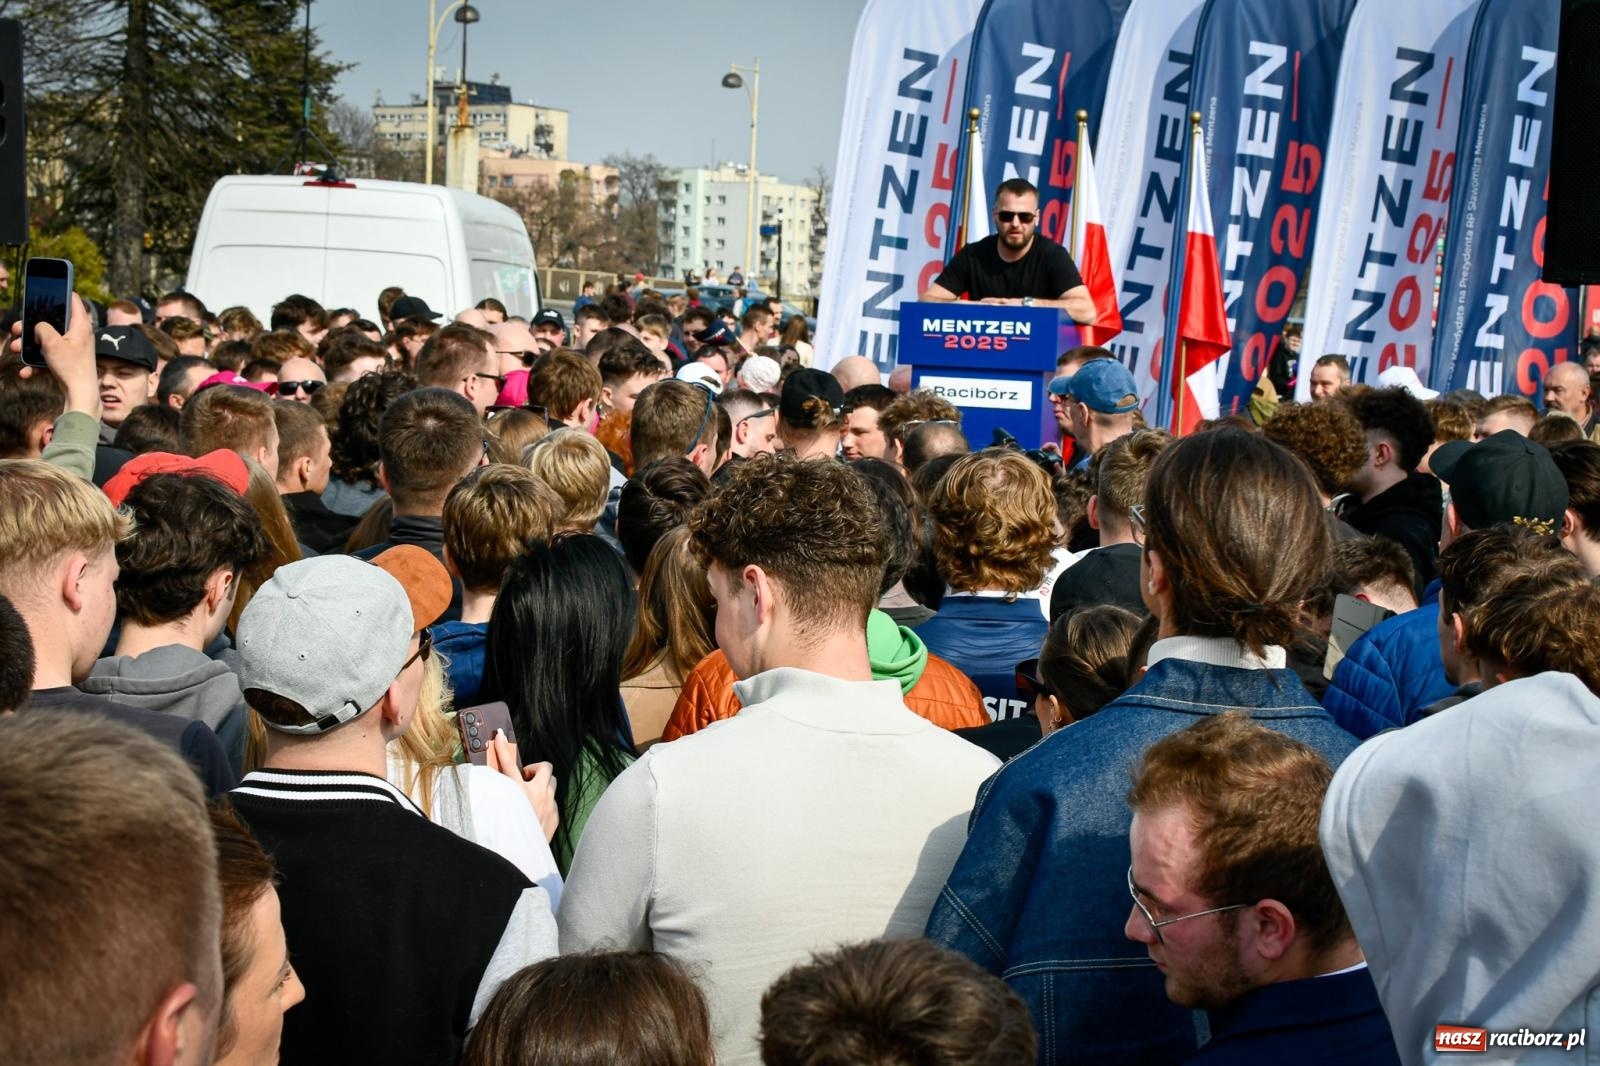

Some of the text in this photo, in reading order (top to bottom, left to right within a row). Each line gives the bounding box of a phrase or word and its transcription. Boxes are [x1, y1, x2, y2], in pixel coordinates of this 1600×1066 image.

[858, 47, 939, 374] ENTZEN
[1110, 49, 1193, 376] NTZEN
[1215, 40, 1287, 390] NTZEN
[1240, 140, 1322, 382] 2025
[1343, 46, 1435, 384] NTZEN
[1459, 230, 1474, 288] Prezydenta
[1466, 213, 1475, 228] RP
[1466, 46, 1556, 401] ENTZEN
[923, 318, 1031, 335] MENTZEN
[944, 334, 1008, 350] 2025
[1459, 289, 1466, 303] na
[934, 385, 1019, 400] Racibórz
